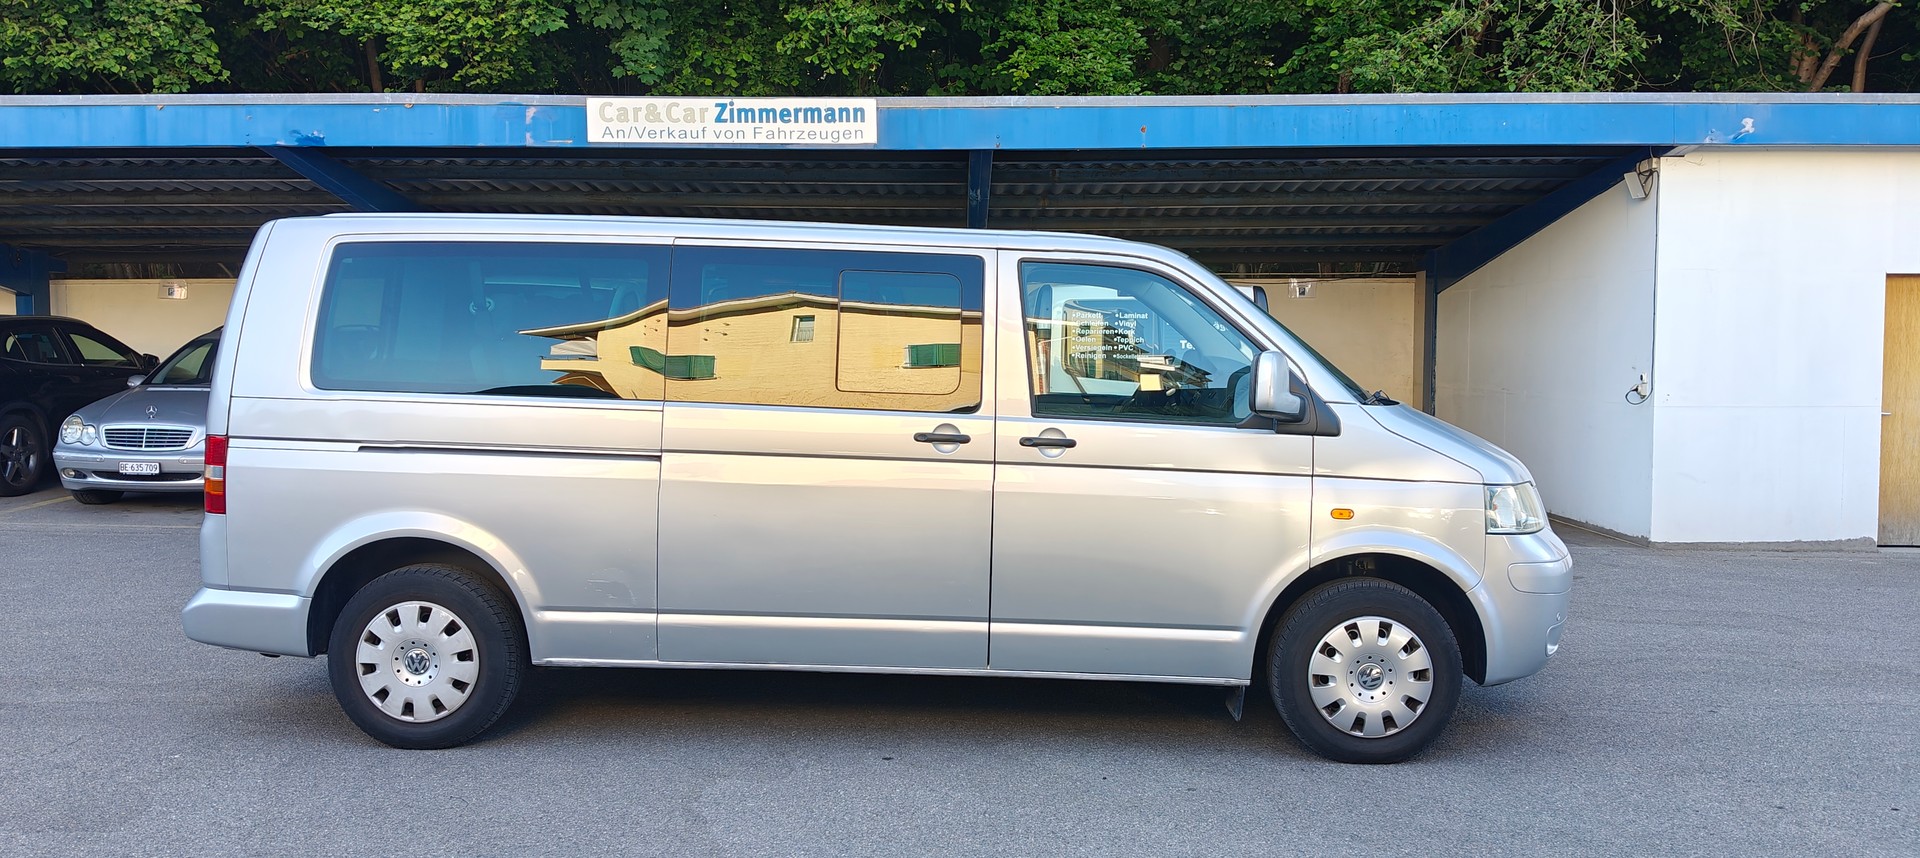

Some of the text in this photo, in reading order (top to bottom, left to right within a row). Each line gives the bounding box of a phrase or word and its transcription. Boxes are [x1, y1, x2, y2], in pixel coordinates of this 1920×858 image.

[599, 101, 866, 124] Car&Car Zimmermann
[601, 126, 865, 143] An/Verkauf von Fahrzeugen
[1118, 320, 1137, 328] Vinyl
[1075, 328, 1115, 336] Reparieren
